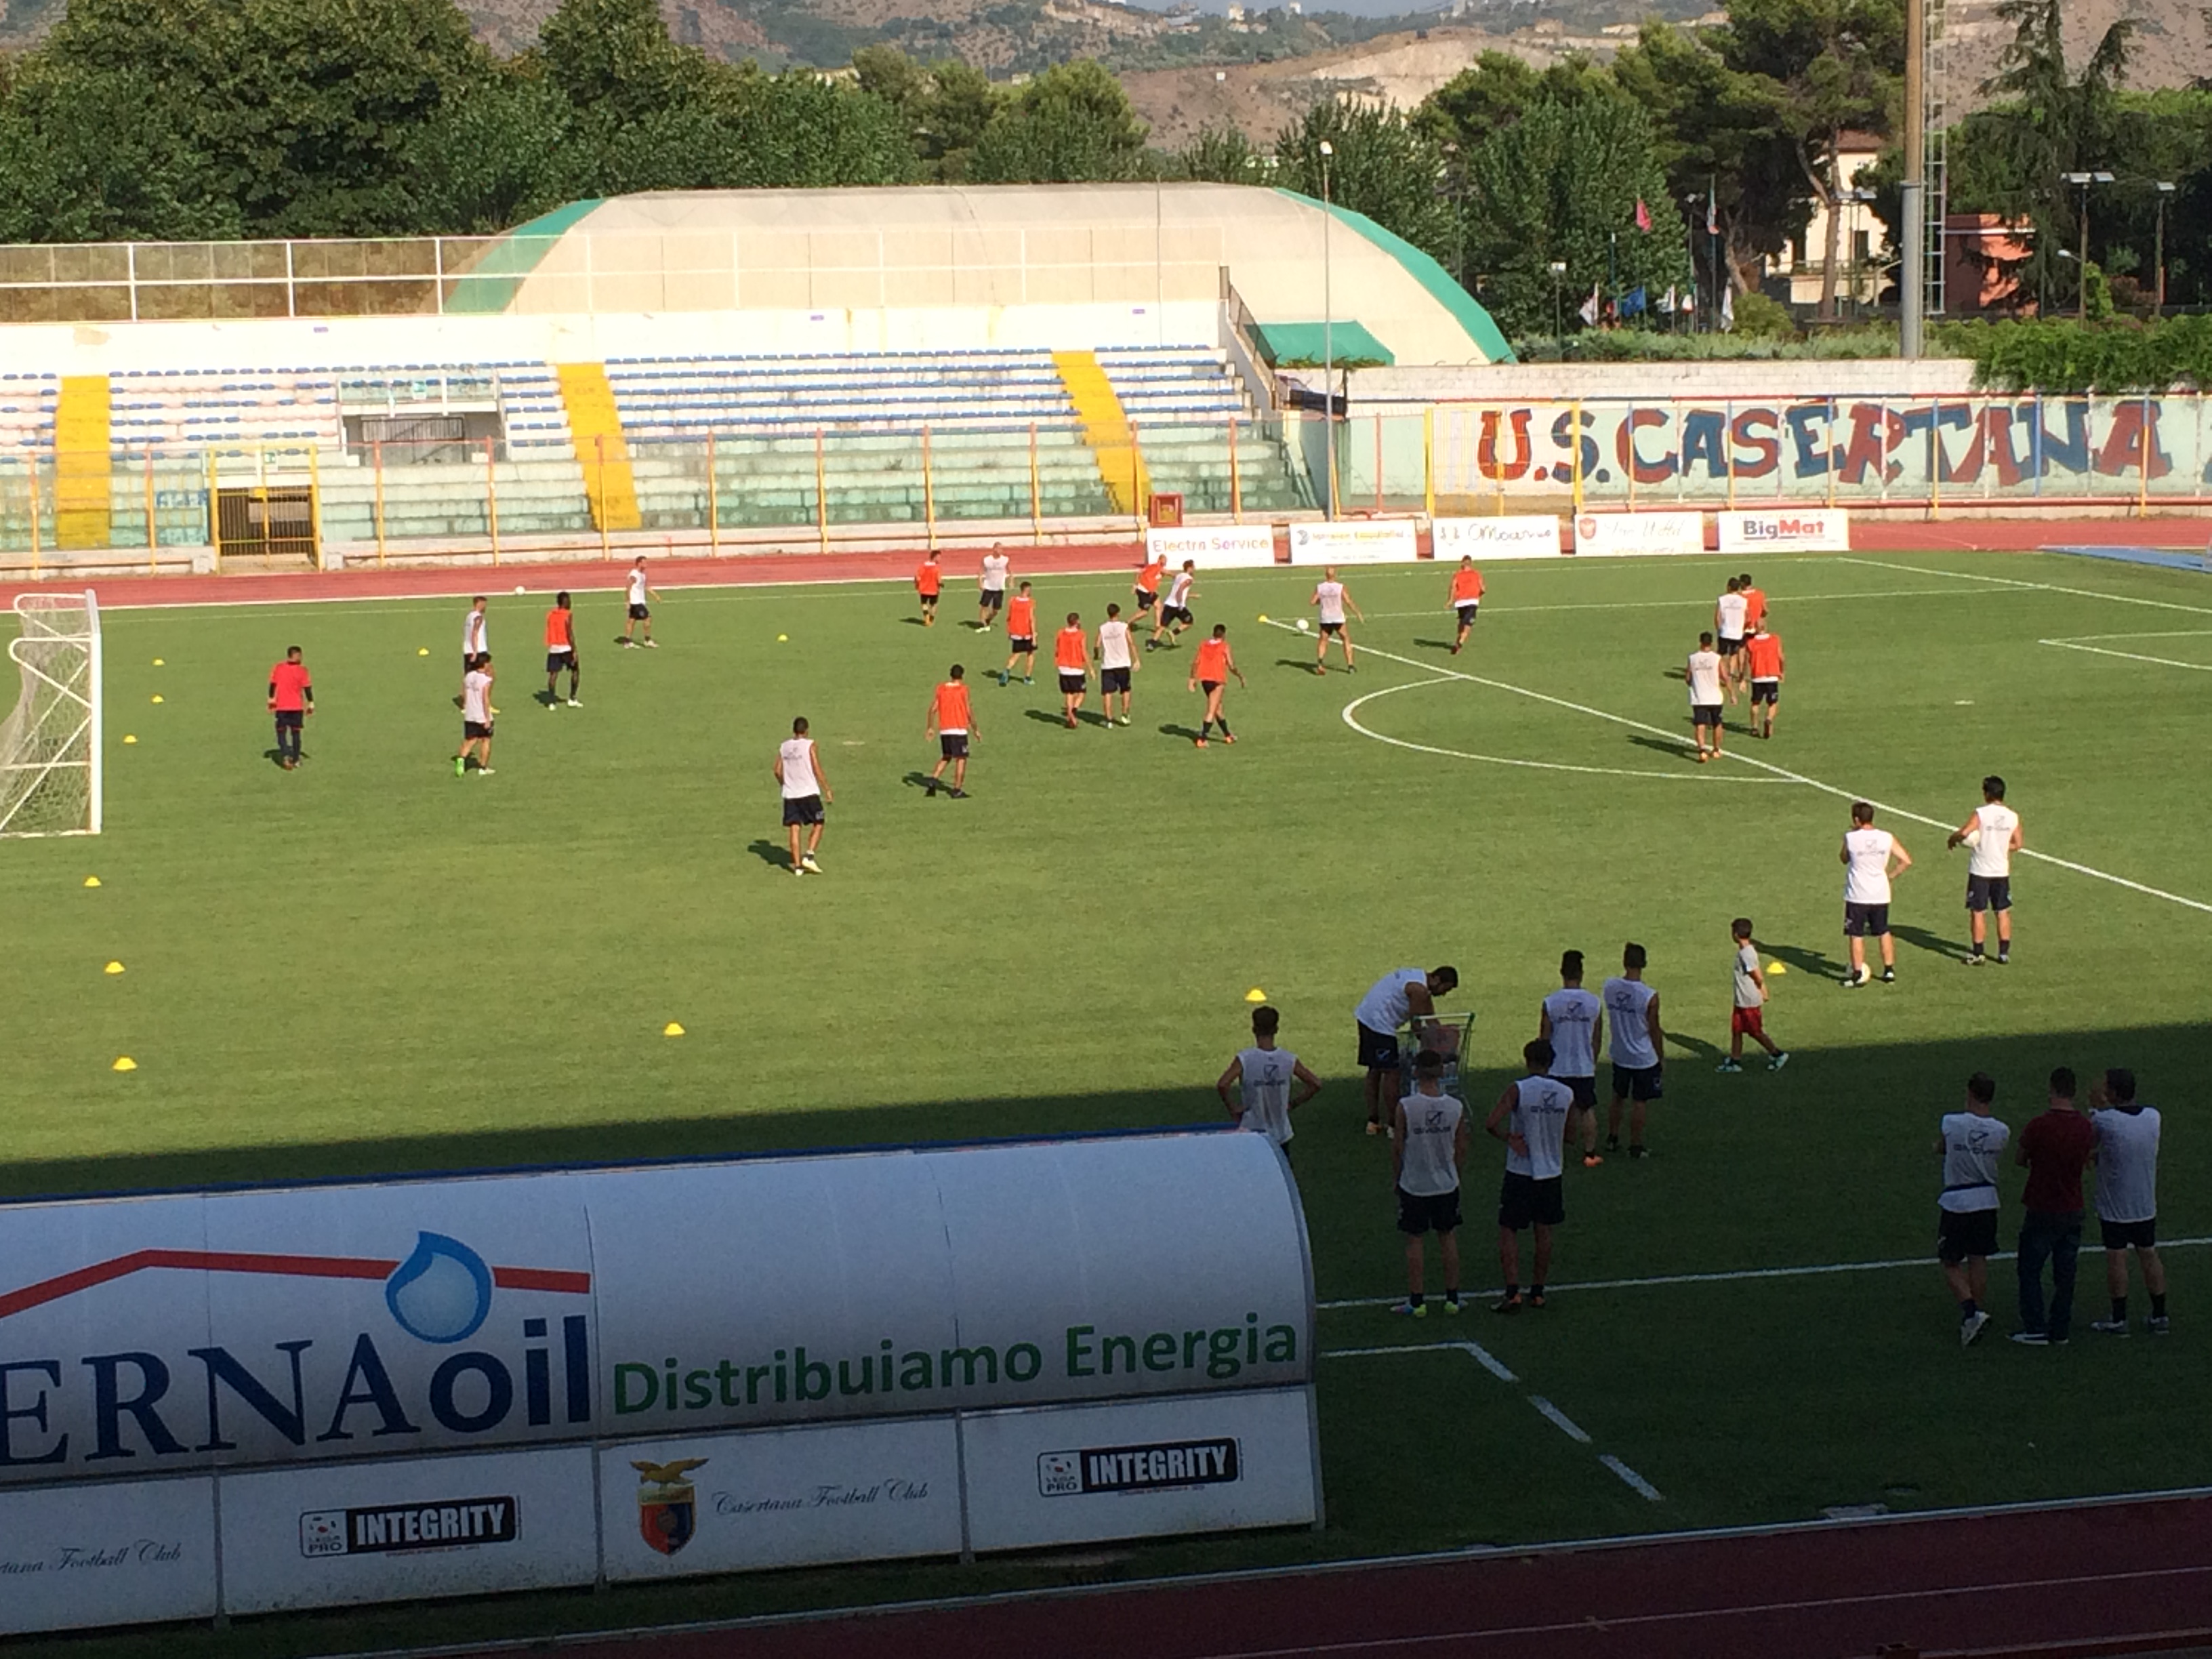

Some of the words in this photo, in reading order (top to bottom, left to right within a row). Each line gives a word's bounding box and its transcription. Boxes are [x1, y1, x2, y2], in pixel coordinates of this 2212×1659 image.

[1212, 537, 1269, 550] Service
[1743, 519, 1825, 540] BigMat
[614, 1339, 1042, 1415] Distribuiamo
[1065, 1313, 1296, 1380] Energia
[1088, 1445, 1228, 1486] INTEGRITY
[811, 1484, 879, 1509] Football
[883, 1477, 929, 1500] Club
[1046, 1483, 1078, 1491] PRO
[355, 1502, 505, 1546] INTEGRITY
[54, 1546, 129, 1571] Football
[134, 1538, 182, 1562] Club
[308, 1542, 342, 1553] PRO
